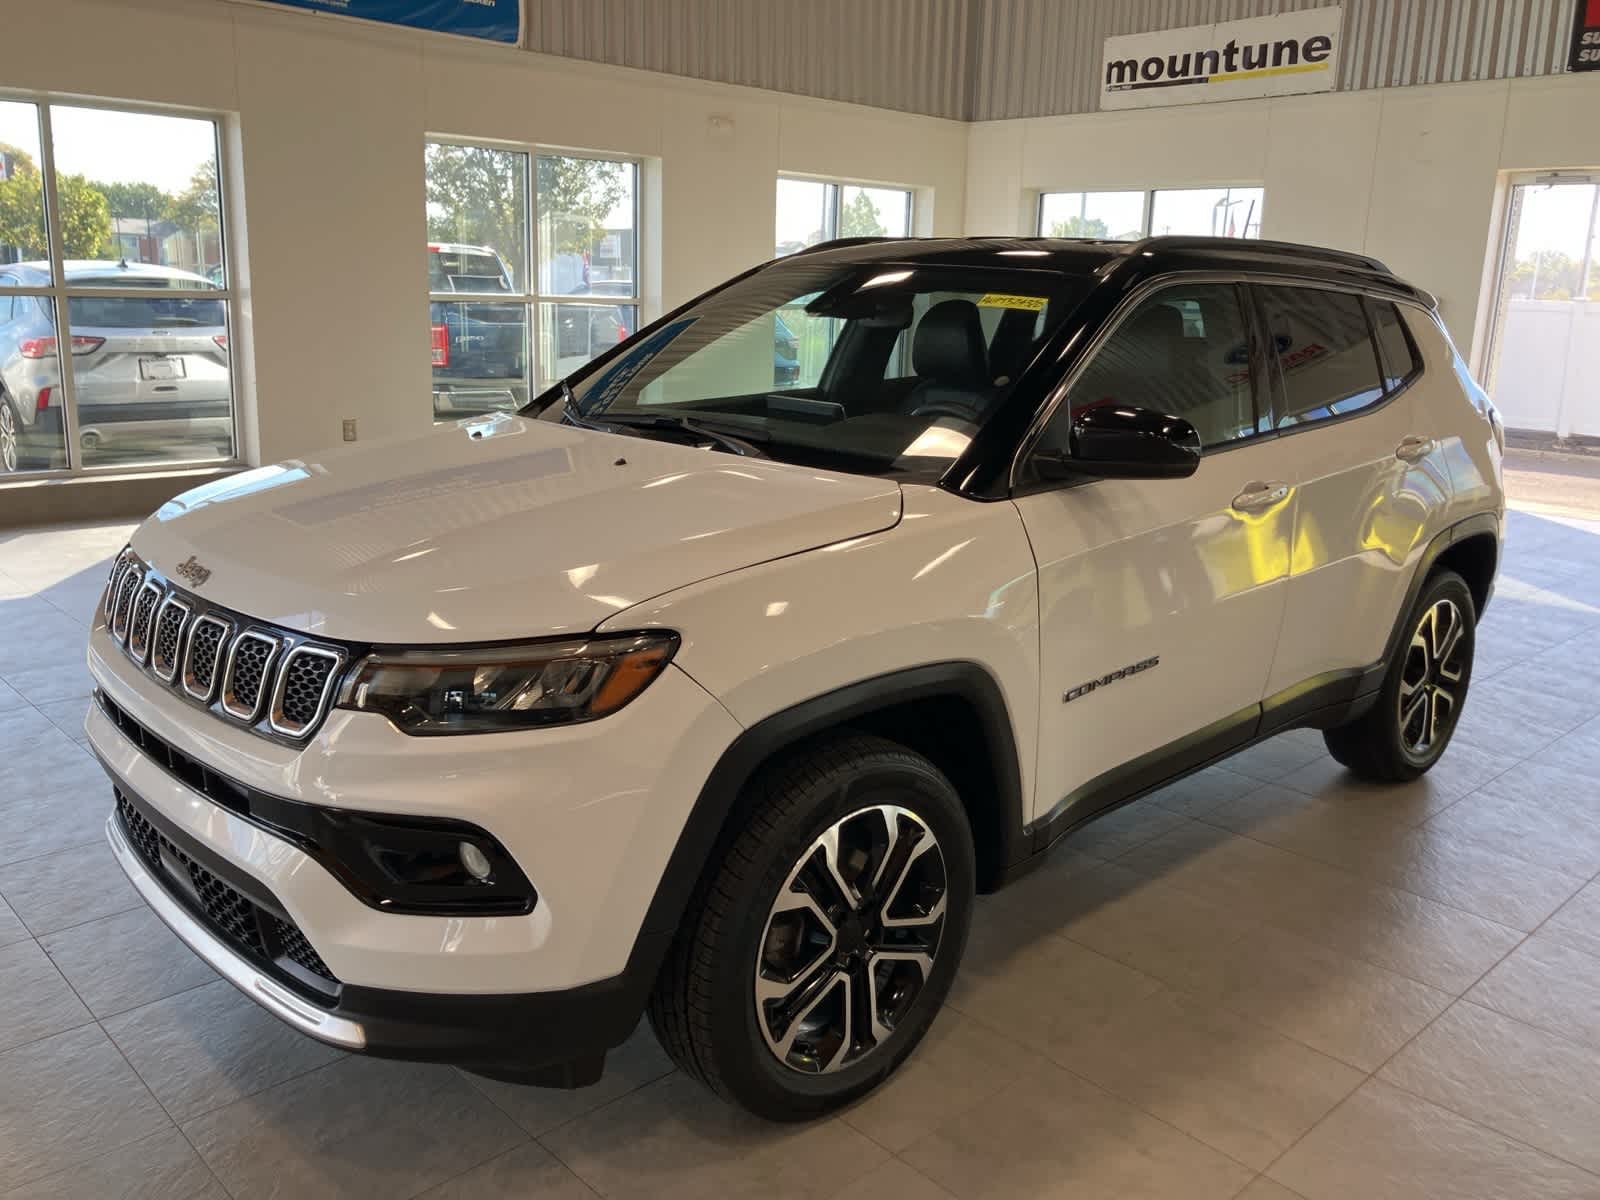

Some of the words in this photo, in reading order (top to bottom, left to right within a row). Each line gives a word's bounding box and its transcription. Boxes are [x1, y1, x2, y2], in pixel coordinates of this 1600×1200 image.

[1105, 35, 1332, 85] mountune
[175, 556, 212, 588] Jeep
[1062, 656, 1160, 703] COMPASS
